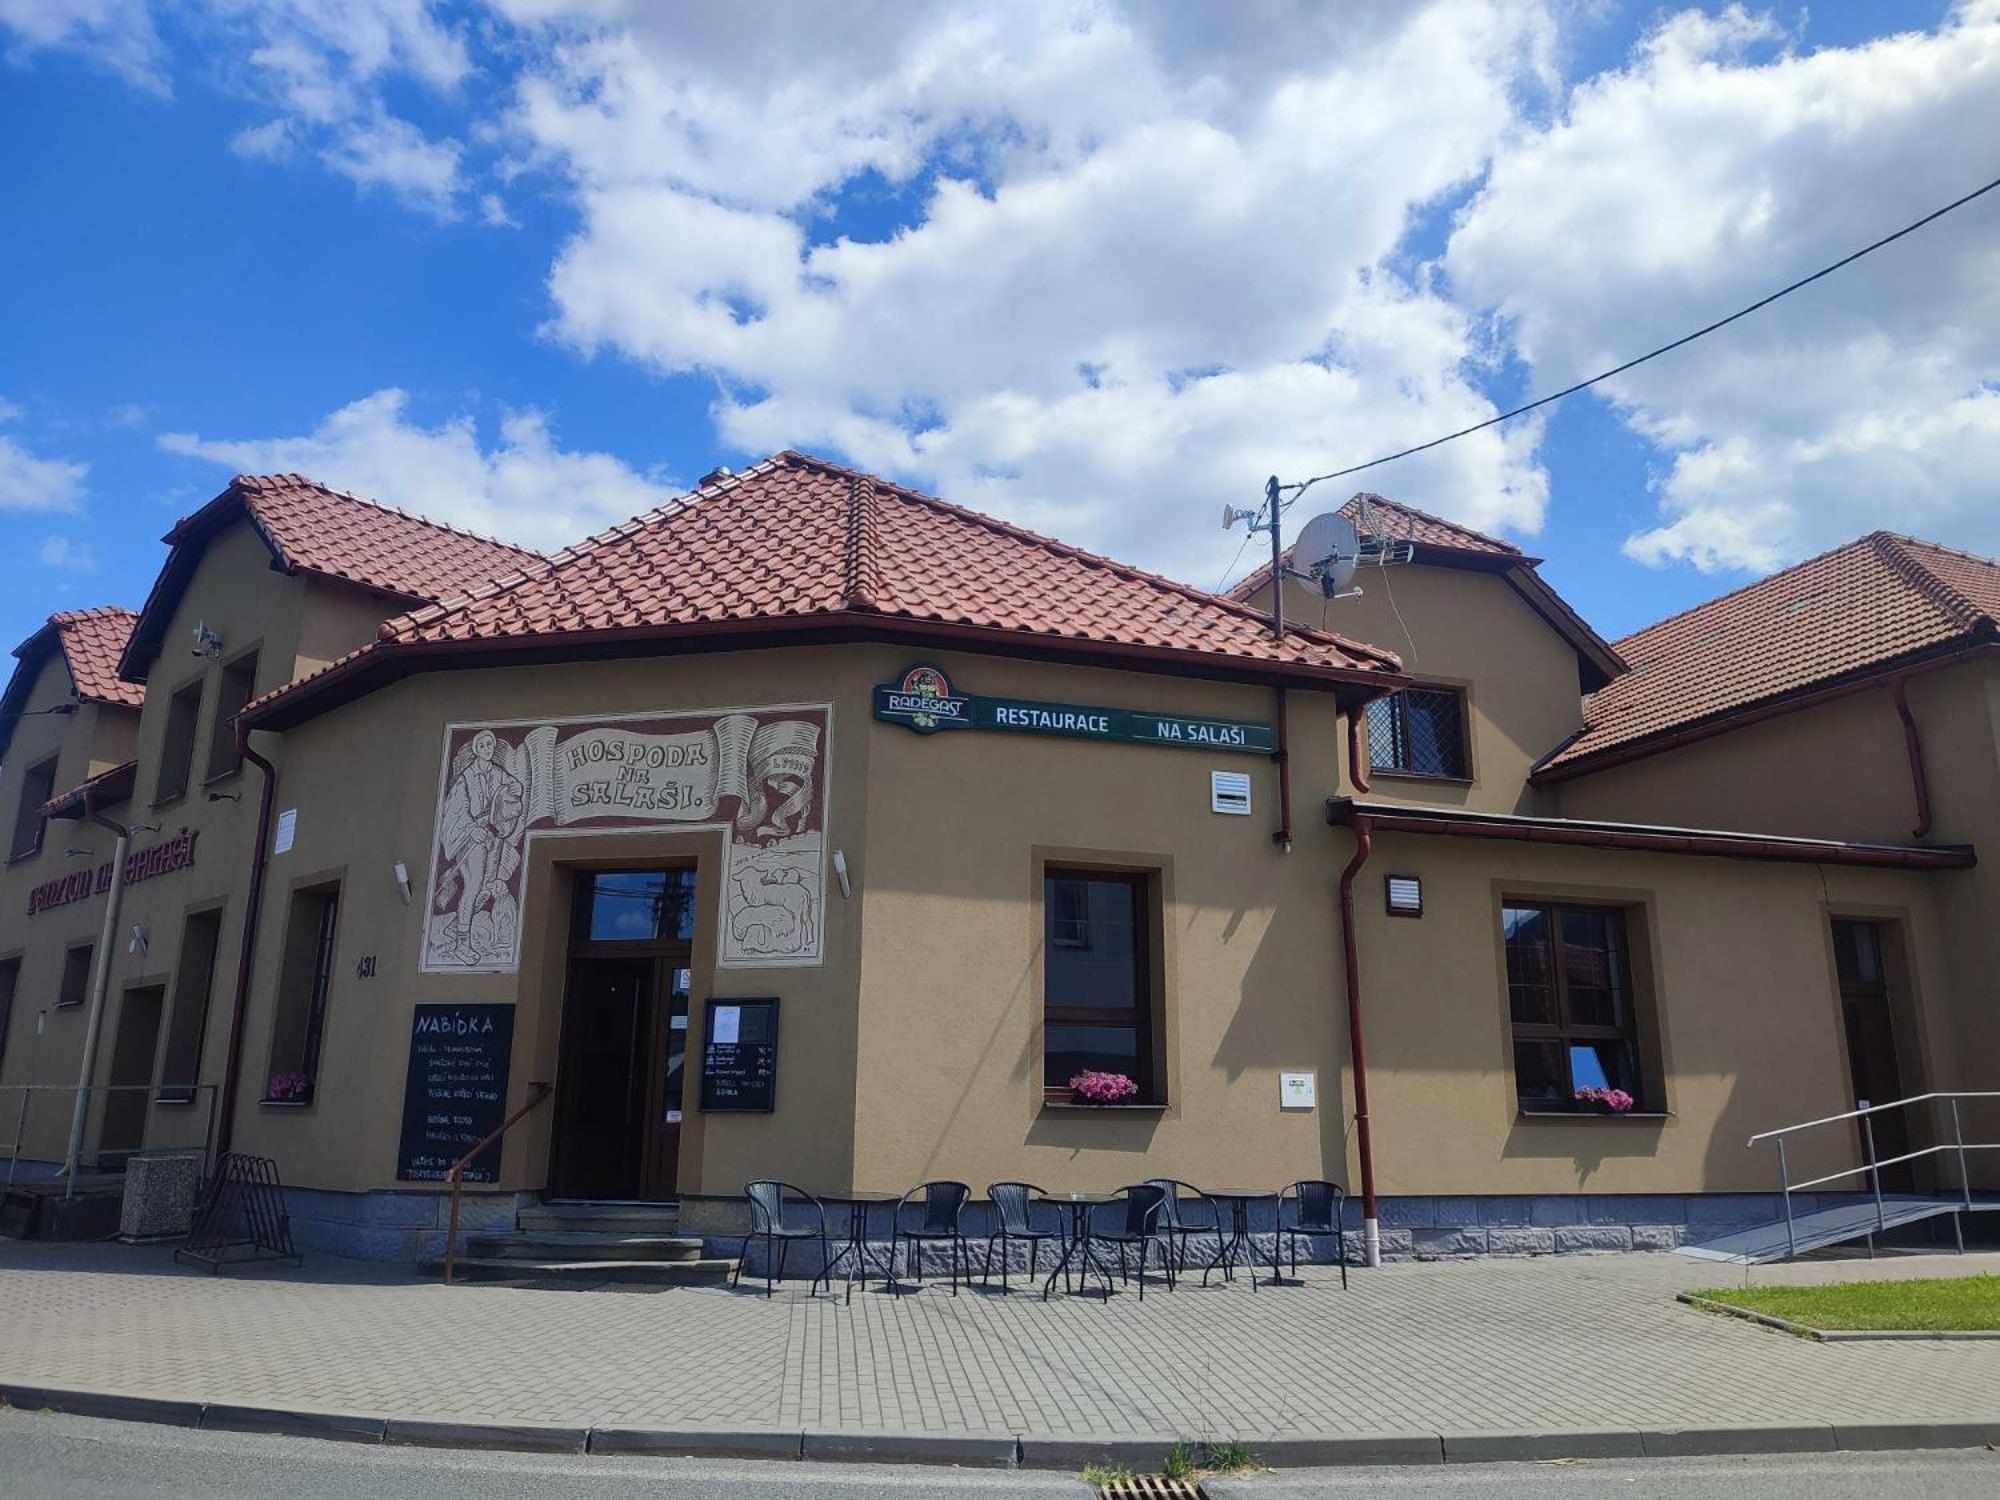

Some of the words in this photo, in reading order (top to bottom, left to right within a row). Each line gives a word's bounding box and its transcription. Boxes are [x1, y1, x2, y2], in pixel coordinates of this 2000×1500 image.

[889, 695, 963, 716] RADEGAST
[996, 707, 1109, 733] RESTAURACE
[1158, 721, 1181, 740] NA
[1187, 725, 1245, 746] SALAŠI
[566, 739, 707, 769] HOSPODA
[617, 767, 650, 784] NA
[416, 1011, 494, 1035] NABÍDKA
